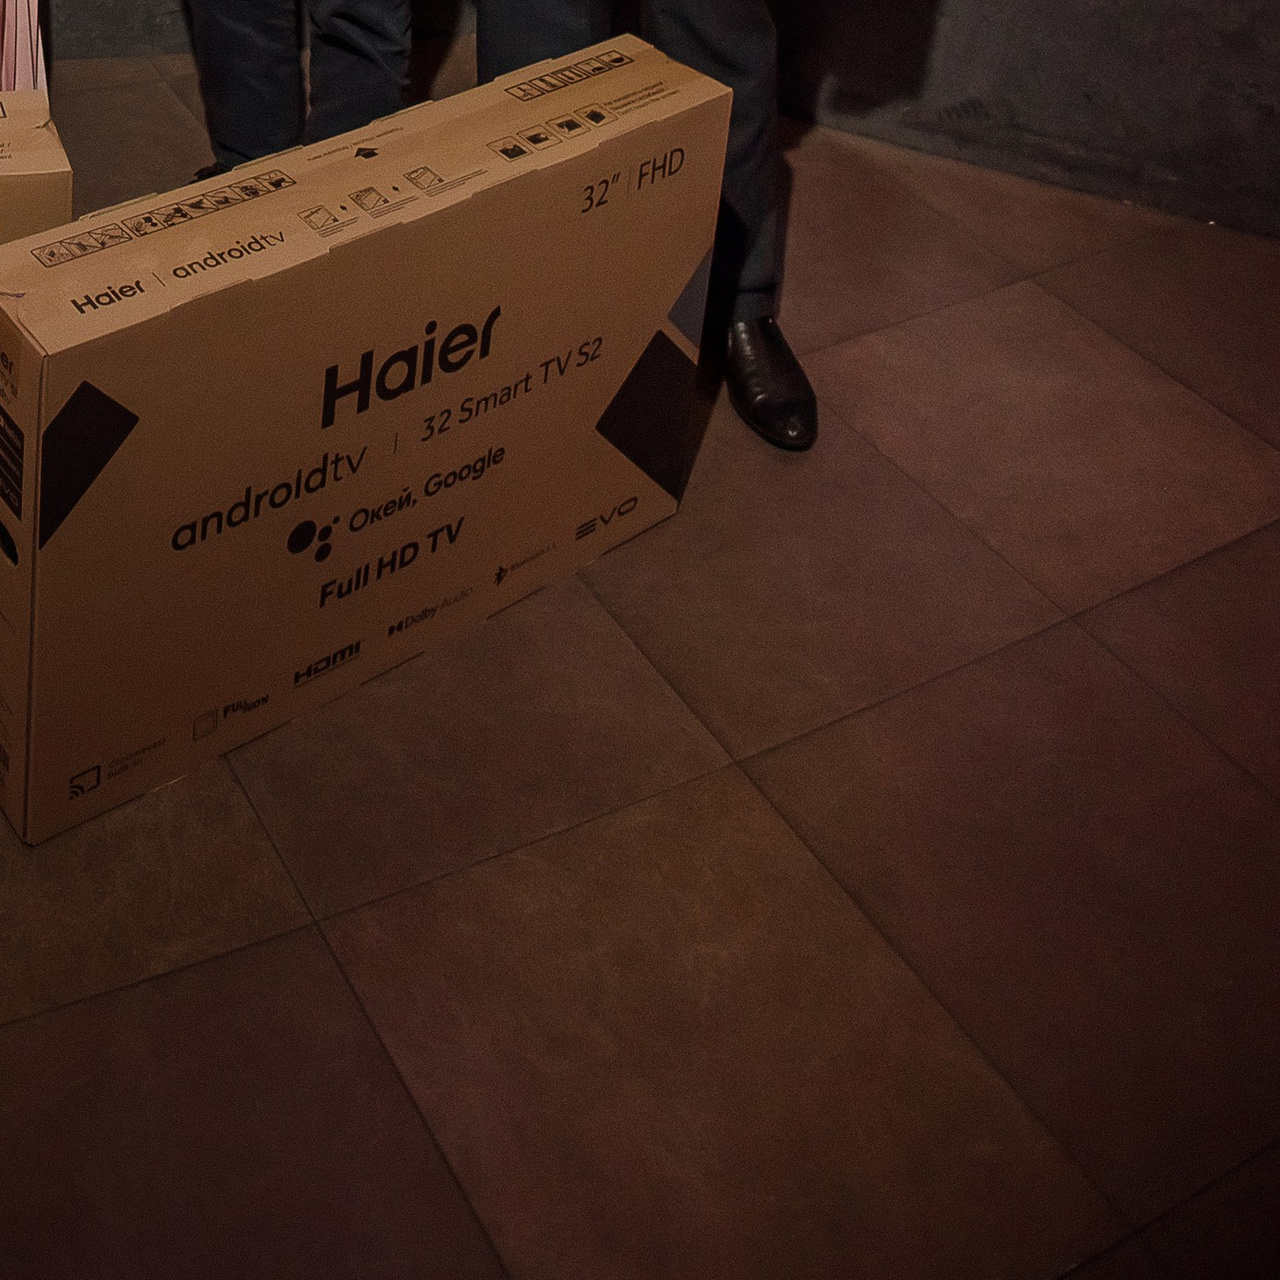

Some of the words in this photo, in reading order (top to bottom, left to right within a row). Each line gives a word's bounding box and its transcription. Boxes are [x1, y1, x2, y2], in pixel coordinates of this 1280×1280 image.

[637, 147, 685, 191] FHD
[70, 279, 146, 314] Haier
[172, 230, 286, 279] androidtv
[320, 305, 502, 430] Haier
[171, 446, 368, 552] androidtv
[421, 408, 451, 442] 32
[458, 372, 533, 424] Smart
[539, 350, 573, 384] TV
[576, 336, 604, 369] S2
[348, 485, 420, 532] Окей,
[423, 446, 507, 498] Google
[320, 563, 370, 609] Full
[376, 540, 420, 581] HD
[426, 515, 466, 554] TV
[404, 603, 438, 629] Dolby
[294, 640, 361, 684] HDMI
